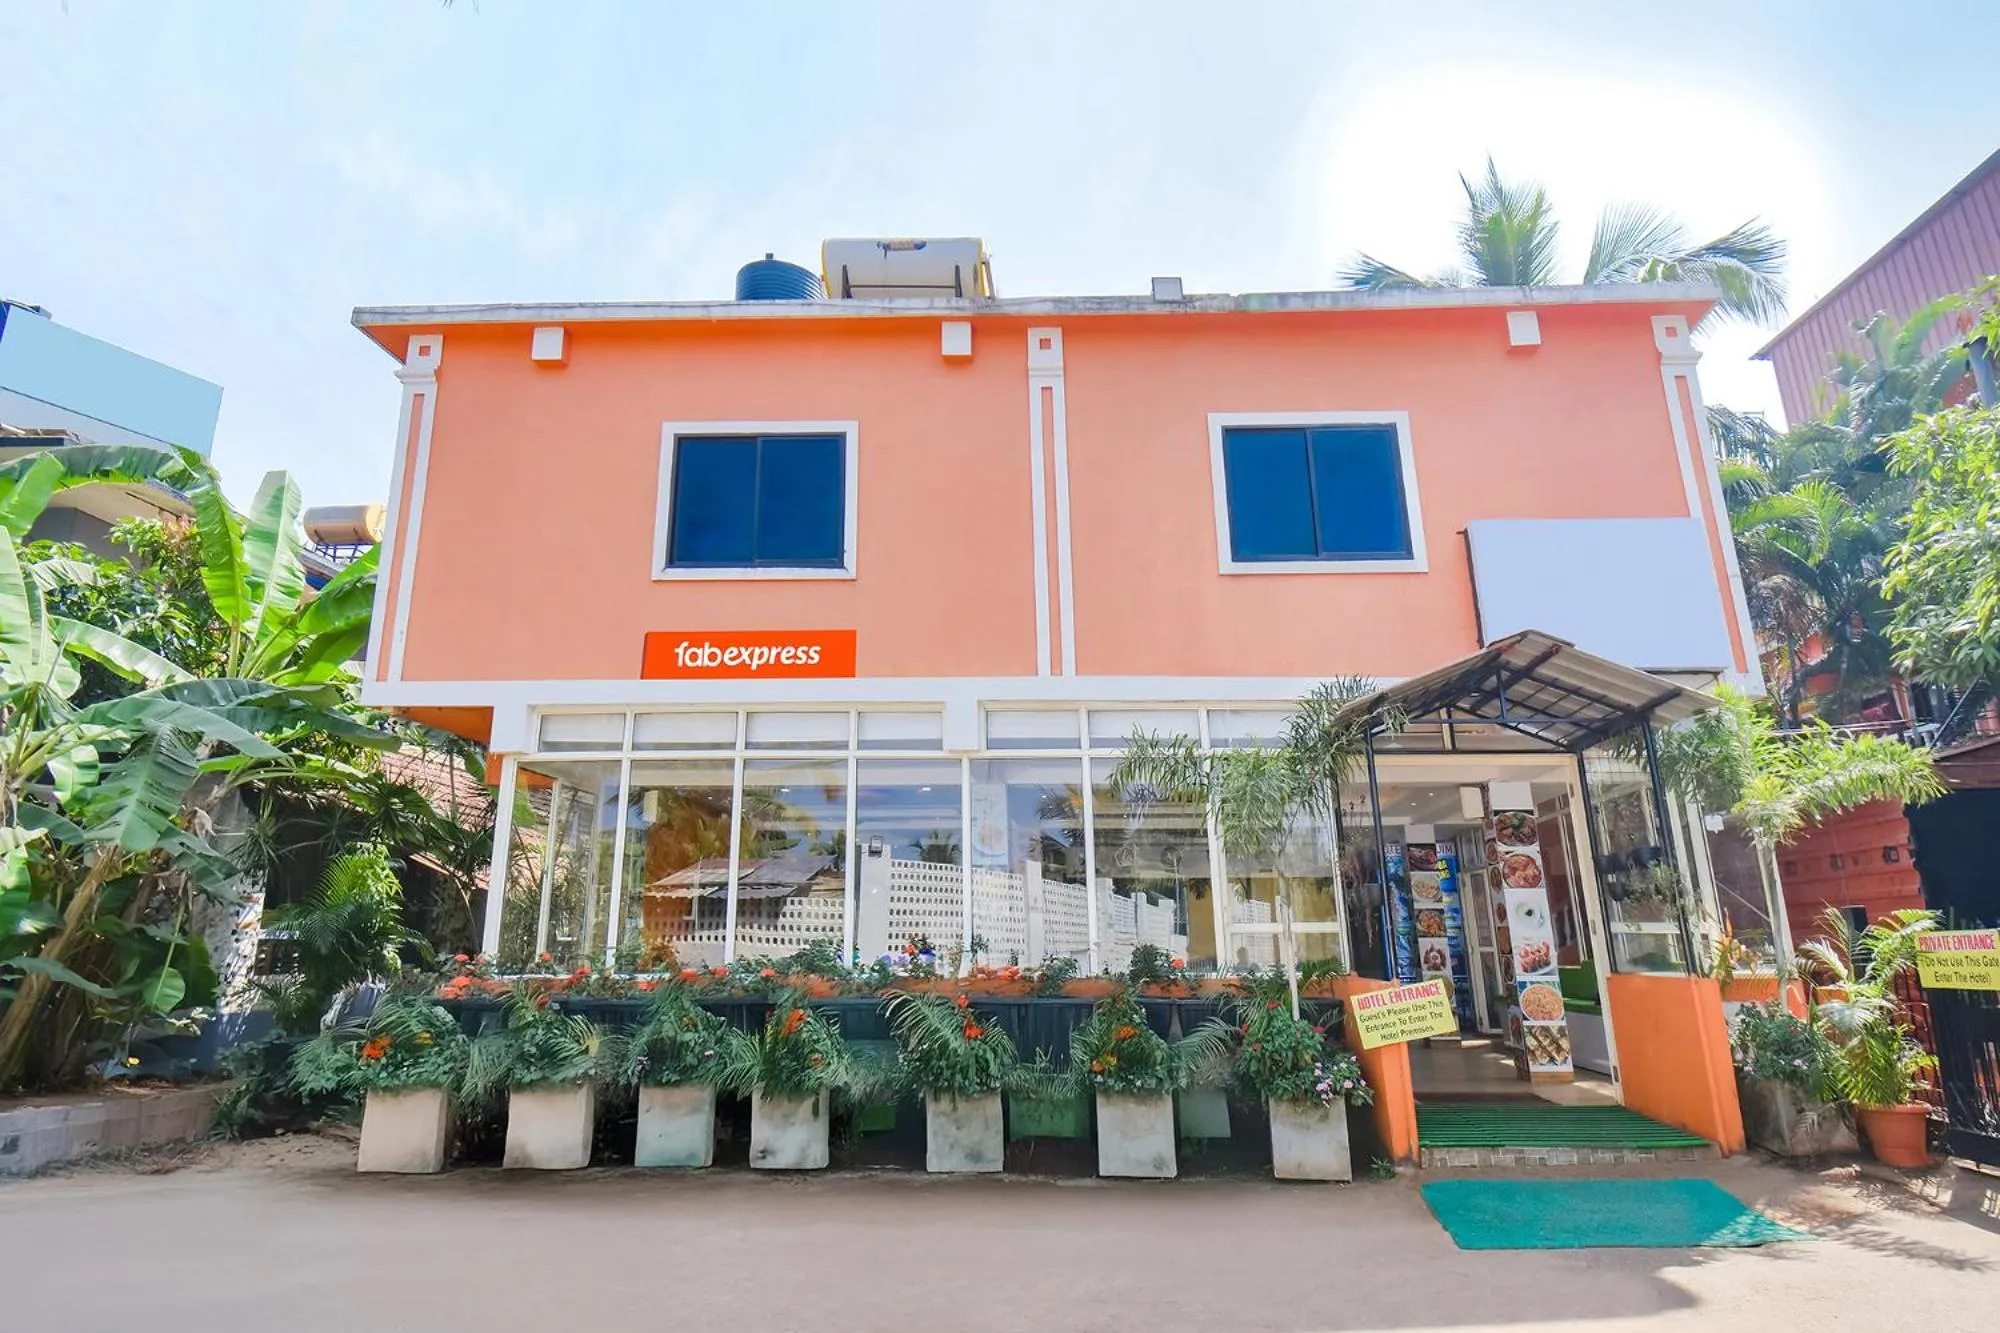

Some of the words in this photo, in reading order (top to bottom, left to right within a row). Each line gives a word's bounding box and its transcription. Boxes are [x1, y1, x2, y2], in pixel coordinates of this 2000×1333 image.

[674, 641, 822, 670] fabexpress
[1919, 936, 1950, 951] PRIVATE
[1952, 934, 1996, 950] ENTRANCE
[1936, 956, 1949, 967] Not
[1950, 956, 1964, 967] Use
[1965, 955, 1981, 967] This
[1982, 955, 2000, 967] Gate
[1934, 971, 1953, 983] Enter
[1953, 971, 1968, 983] The
[1357, 994, 1387, 1010] HOTEL
[1388, 983, 1442, 1003] ENTRANCE
[1360, 1012, 1386, 1023] Guest's
[1387, 1006, 1411, 1016] Please
[1412, 1003, 1427, 1012] Use
[1428, 1000, 1444, 1009] This
[1365, 1021, 1397, 1033] Entrance
[1398, 1018, 1408, 1026] To
[1408, 1016, 1429, 1025] Enter
[1429, 1011, 1444, 1020] The
[1380, 1031, 1399, 1040] Hotel
[1400, 1025, 1434, 1036] Premises
